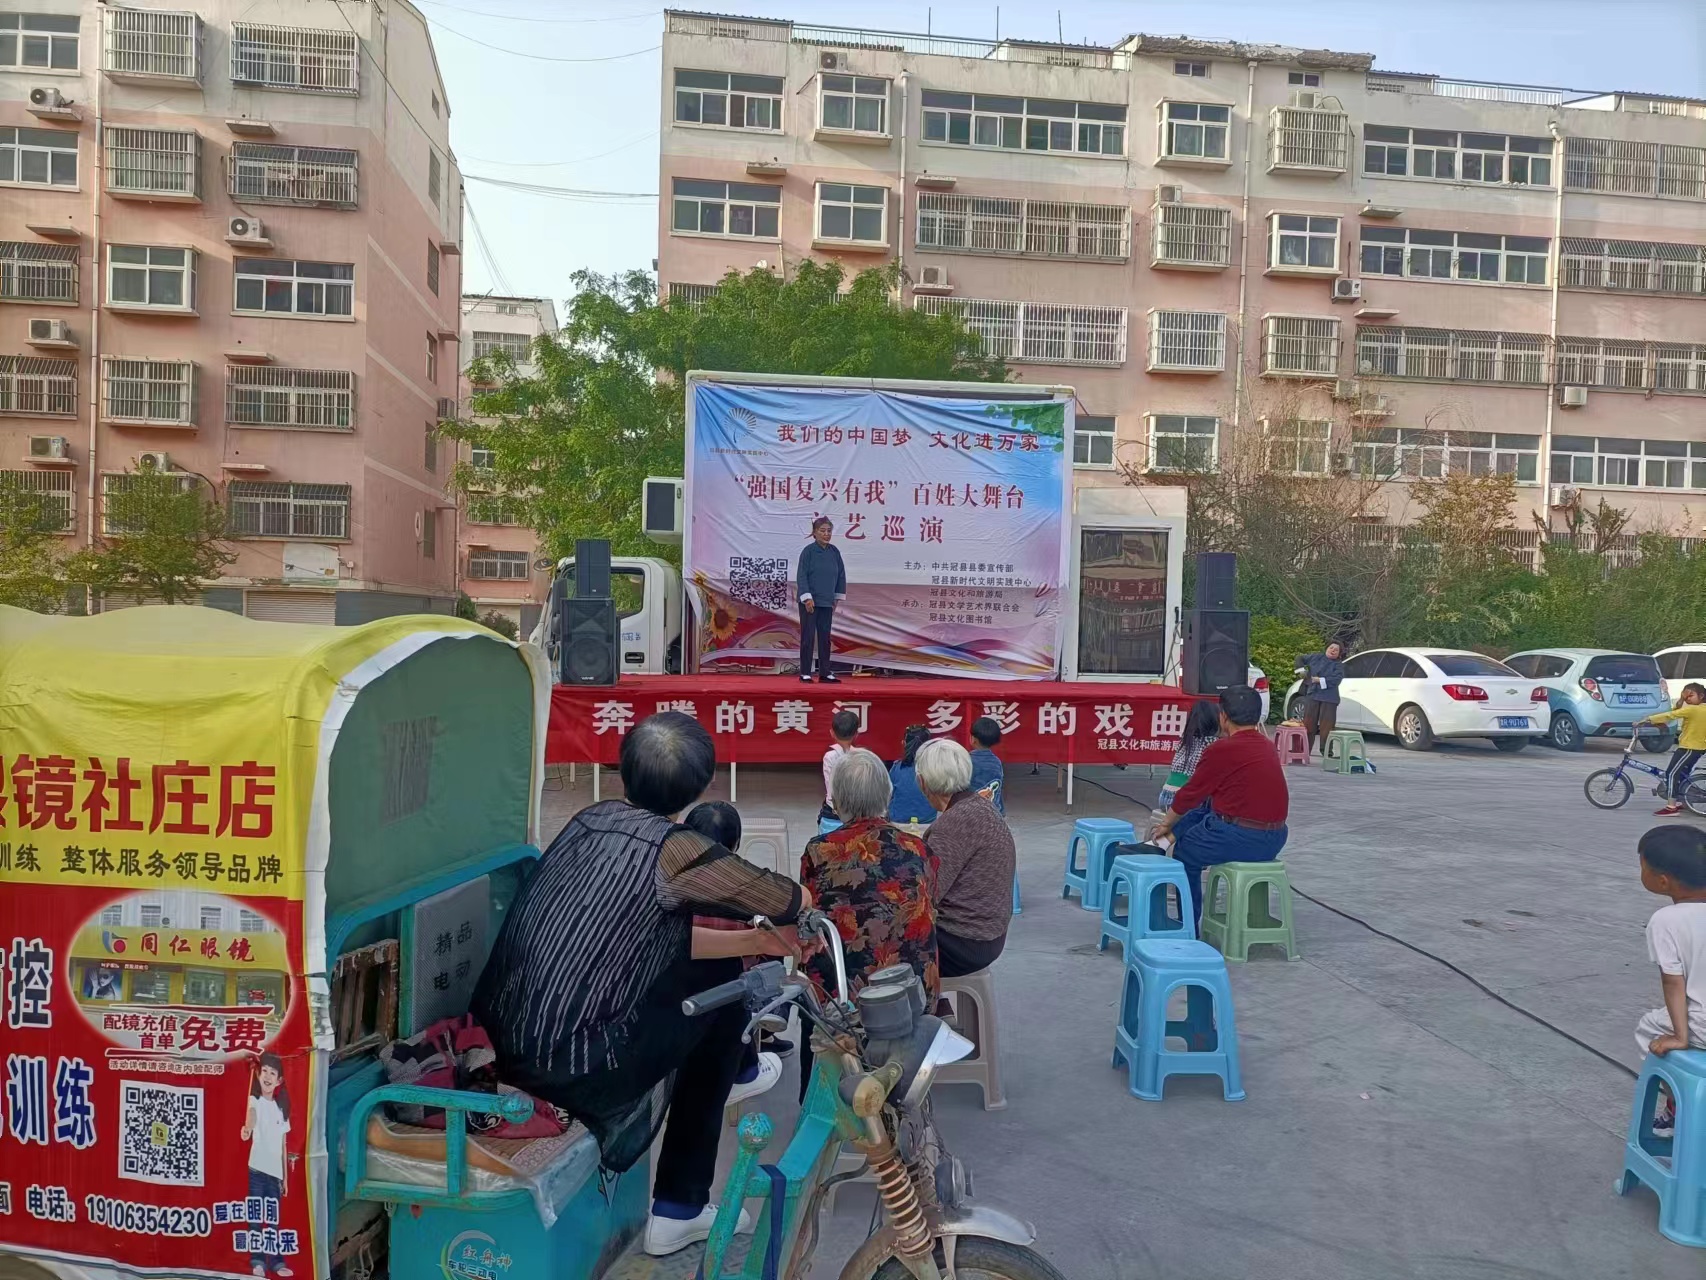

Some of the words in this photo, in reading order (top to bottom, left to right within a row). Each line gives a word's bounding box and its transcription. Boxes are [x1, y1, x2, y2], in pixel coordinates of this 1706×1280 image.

[777, 424, 912, 447] 我们的中国梦
[928, 431, 1040, 452] 文化进万家
[913, 483, 1025, 509] 百姓大舞台
[804, 511, 944, 544] 艺巡演
[931, 562, 1014, 573] 中共冠县县委宣传部
[931, 575, 1032, 587] 冠县新时代文明实践中心
[929, 588, 1003, 599] 冠县文化和旅游局
[929, 600, 1020, 613] 冠县文学艺术界联合会
[929, 612, 993, 625] 冠县文化图书馆
[0, 754, 276, 839] 镜社庄店
[60, 844, 284, 884] 整体服务领导品牌
[140, 932, 256, 962] 同仁眼镜
[434, 920, 473, 957] 精品
[0, 940, 50, 1026] 控
[103, 1013, 178, 1032] 配镜充值
[178, 1016, 267, 1054] 免费
[138, 1032, 175, 1050] 首单
[87, 1196, 209, 1234] 19106354230
[214, 1198, 278, 1223] 爱在眼前
